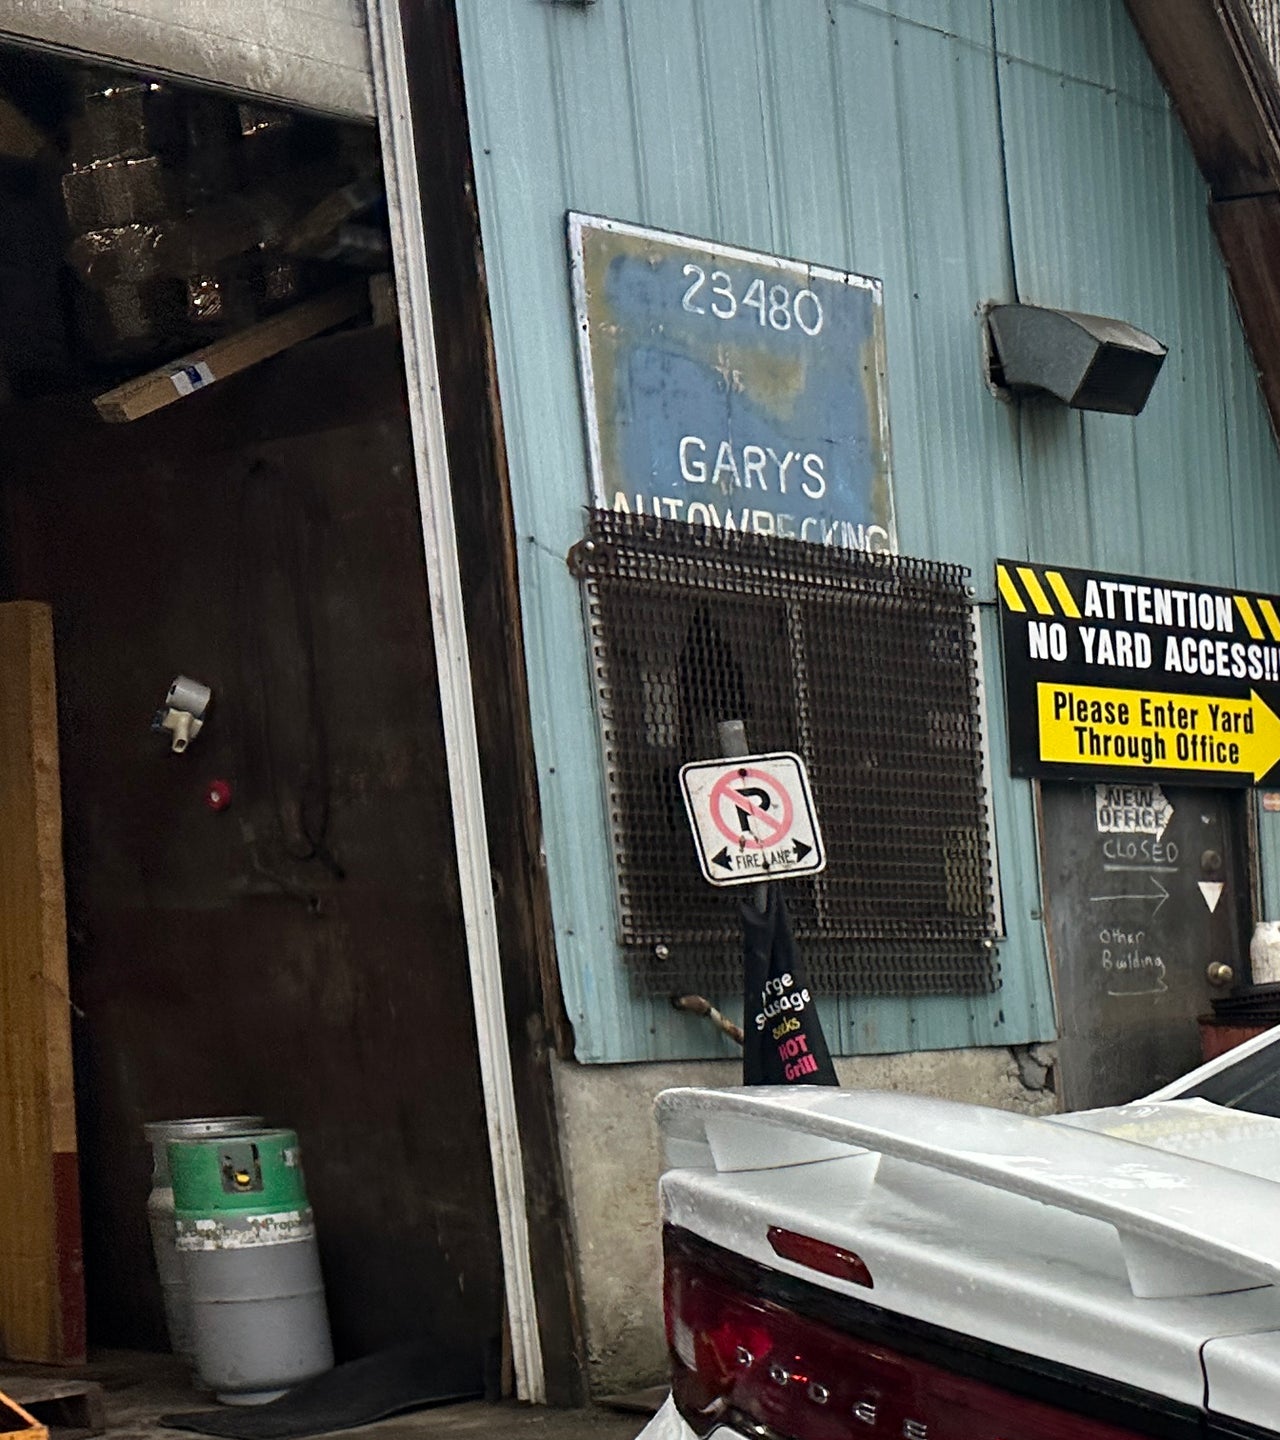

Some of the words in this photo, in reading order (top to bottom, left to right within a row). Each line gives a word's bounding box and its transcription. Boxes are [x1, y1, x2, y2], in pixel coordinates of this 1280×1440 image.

[682, 263, 823, 336] 23480
[679, 436, 826, 499] GARY'S
[1085, 579, 1233, 633] ATTENTION
[1028, 620, 1068, 662] NO
[1079, 626, 1152, 669] YARD
[1053, 691, 1130, 725] Please
[1140, 698, 1199, 730] Enter
[1208, 704, 1254, 735] Yard
[1074, 726, 1166, 764] Through
[1176, 732, 1240, 764] Office
[1099, 805, 1168, 830] OFFICE
[1107, 788, 1152, 807] NEW
[735, 854, 763, 870] FIRE
[1103, 840, 1179, 863] CLOSED
